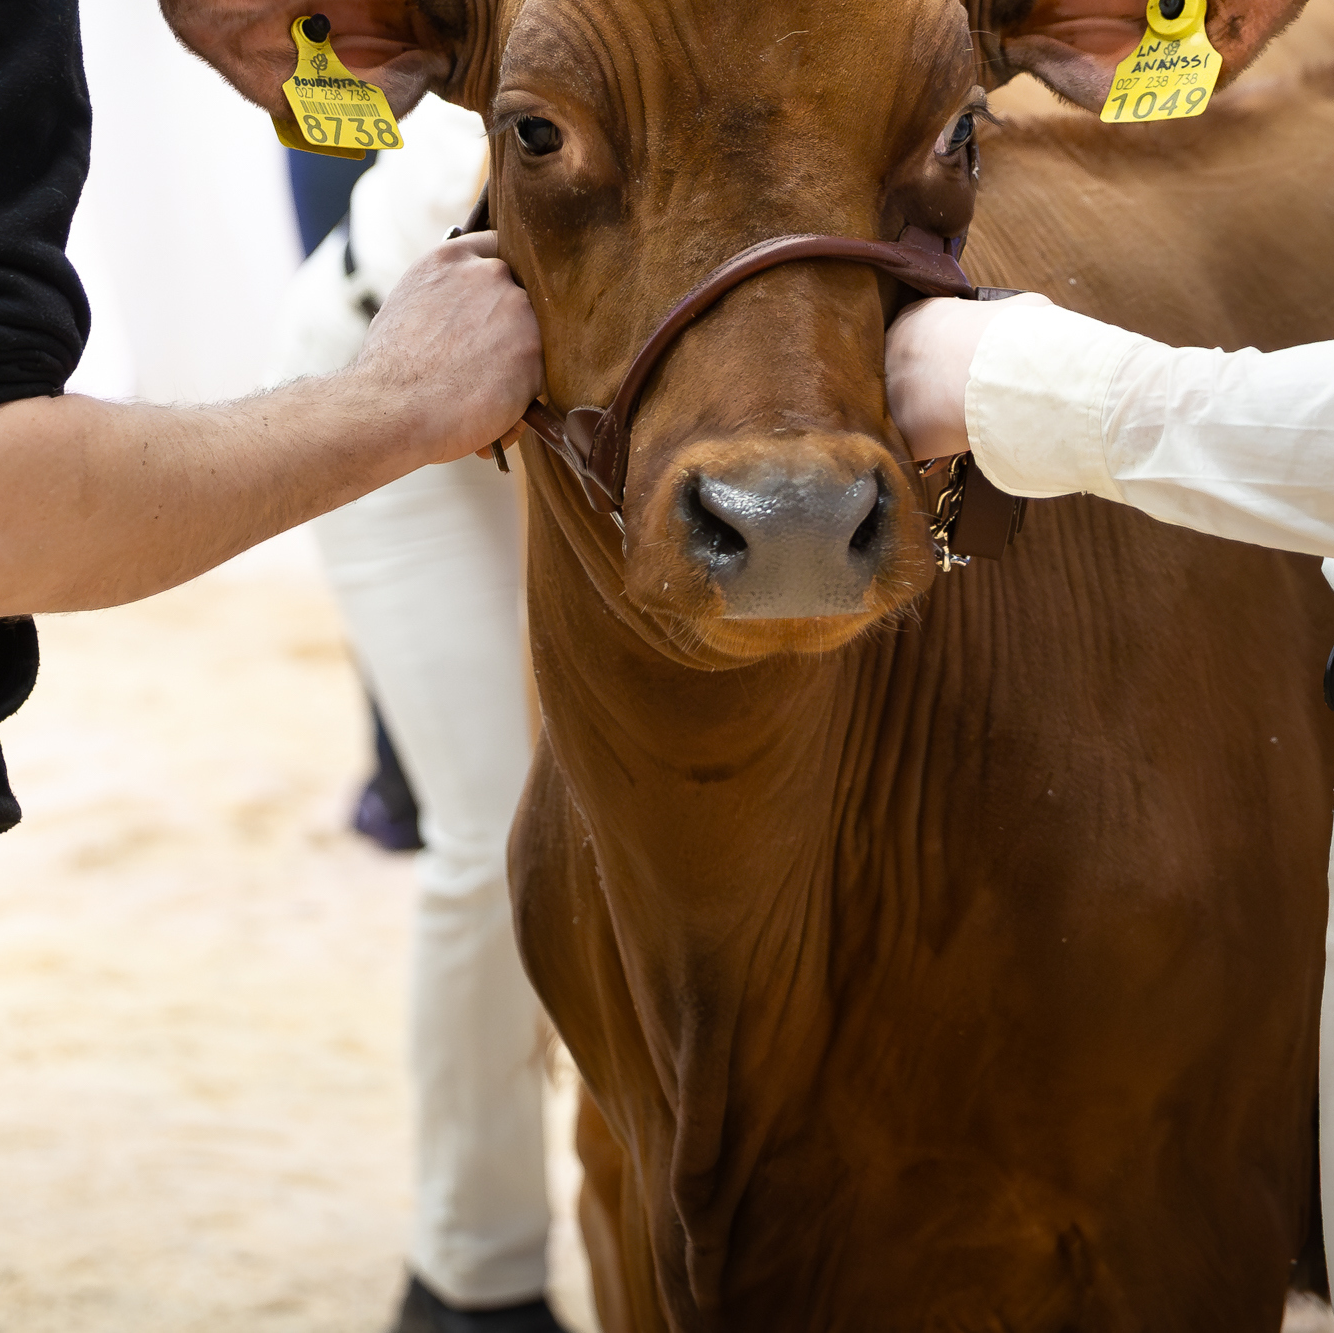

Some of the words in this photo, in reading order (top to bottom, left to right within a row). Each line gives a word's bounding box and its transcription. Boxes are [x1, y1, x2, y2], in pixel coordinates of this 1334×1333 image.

[1136, 41, 1161, 58] LN
[1131, 53, 1210, 73] ANANSSI
[1116, 78, 1140, 90] 027
[1145, 76, 1169, 88] 238
[1174, 73, 1198, 85] 738
[295, 87, 314, 99] 027
[321, 89, 343, 101] 238
[347, 89, 371, 101] 738
[1111, 87, 1207, 120] 1049
[303, 114, 399, 148] 8738
